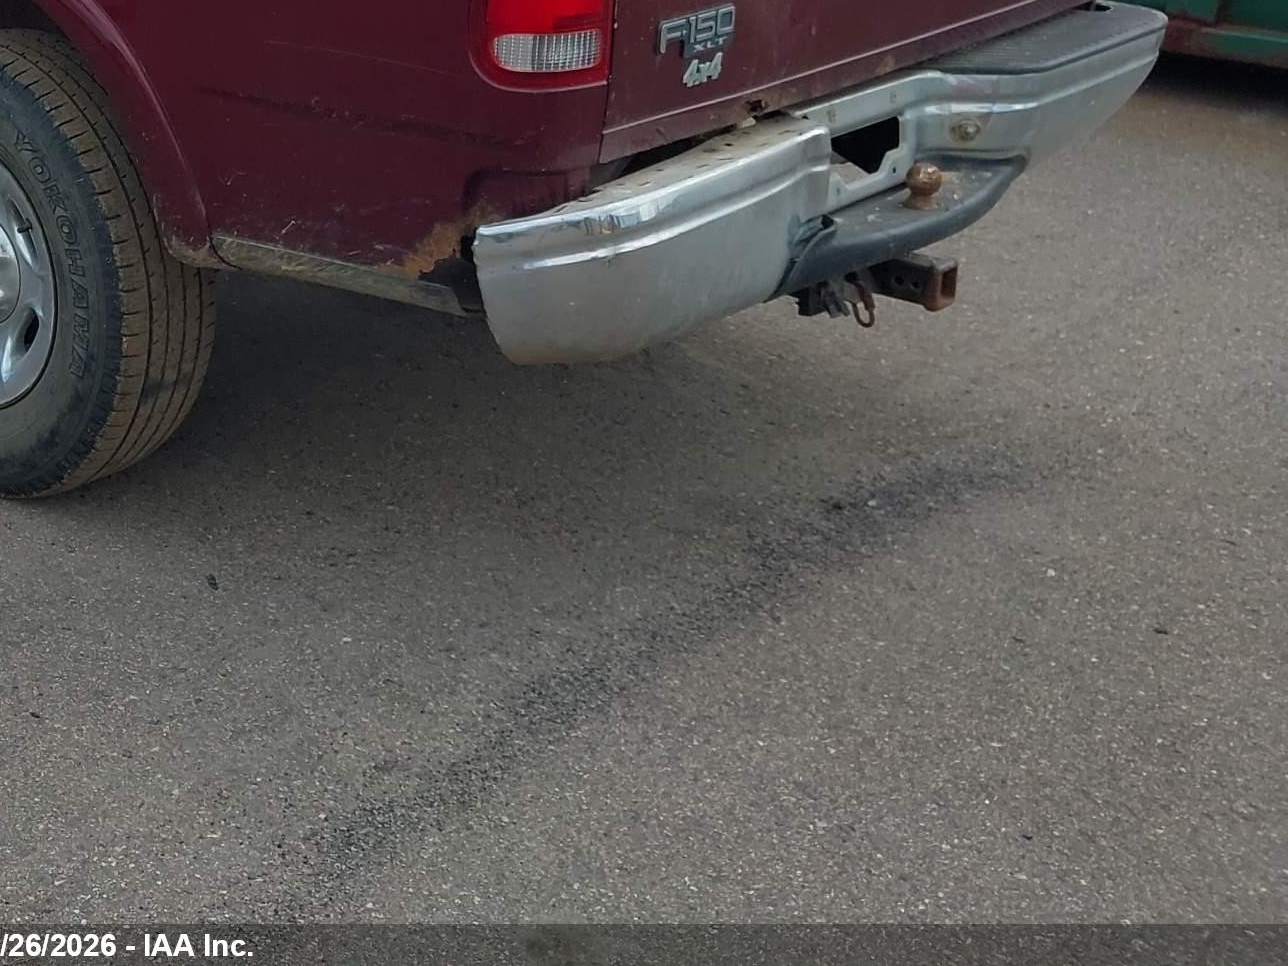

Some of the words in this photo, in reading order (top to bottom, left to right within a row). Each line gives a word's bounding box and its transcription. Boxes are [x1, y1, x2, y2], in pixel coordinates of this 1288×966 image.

[693, 36, 728, 52] XLT
[683, 52, 723, 87] 4x4
[15, 129, 88, 378] YOKOHAMA
